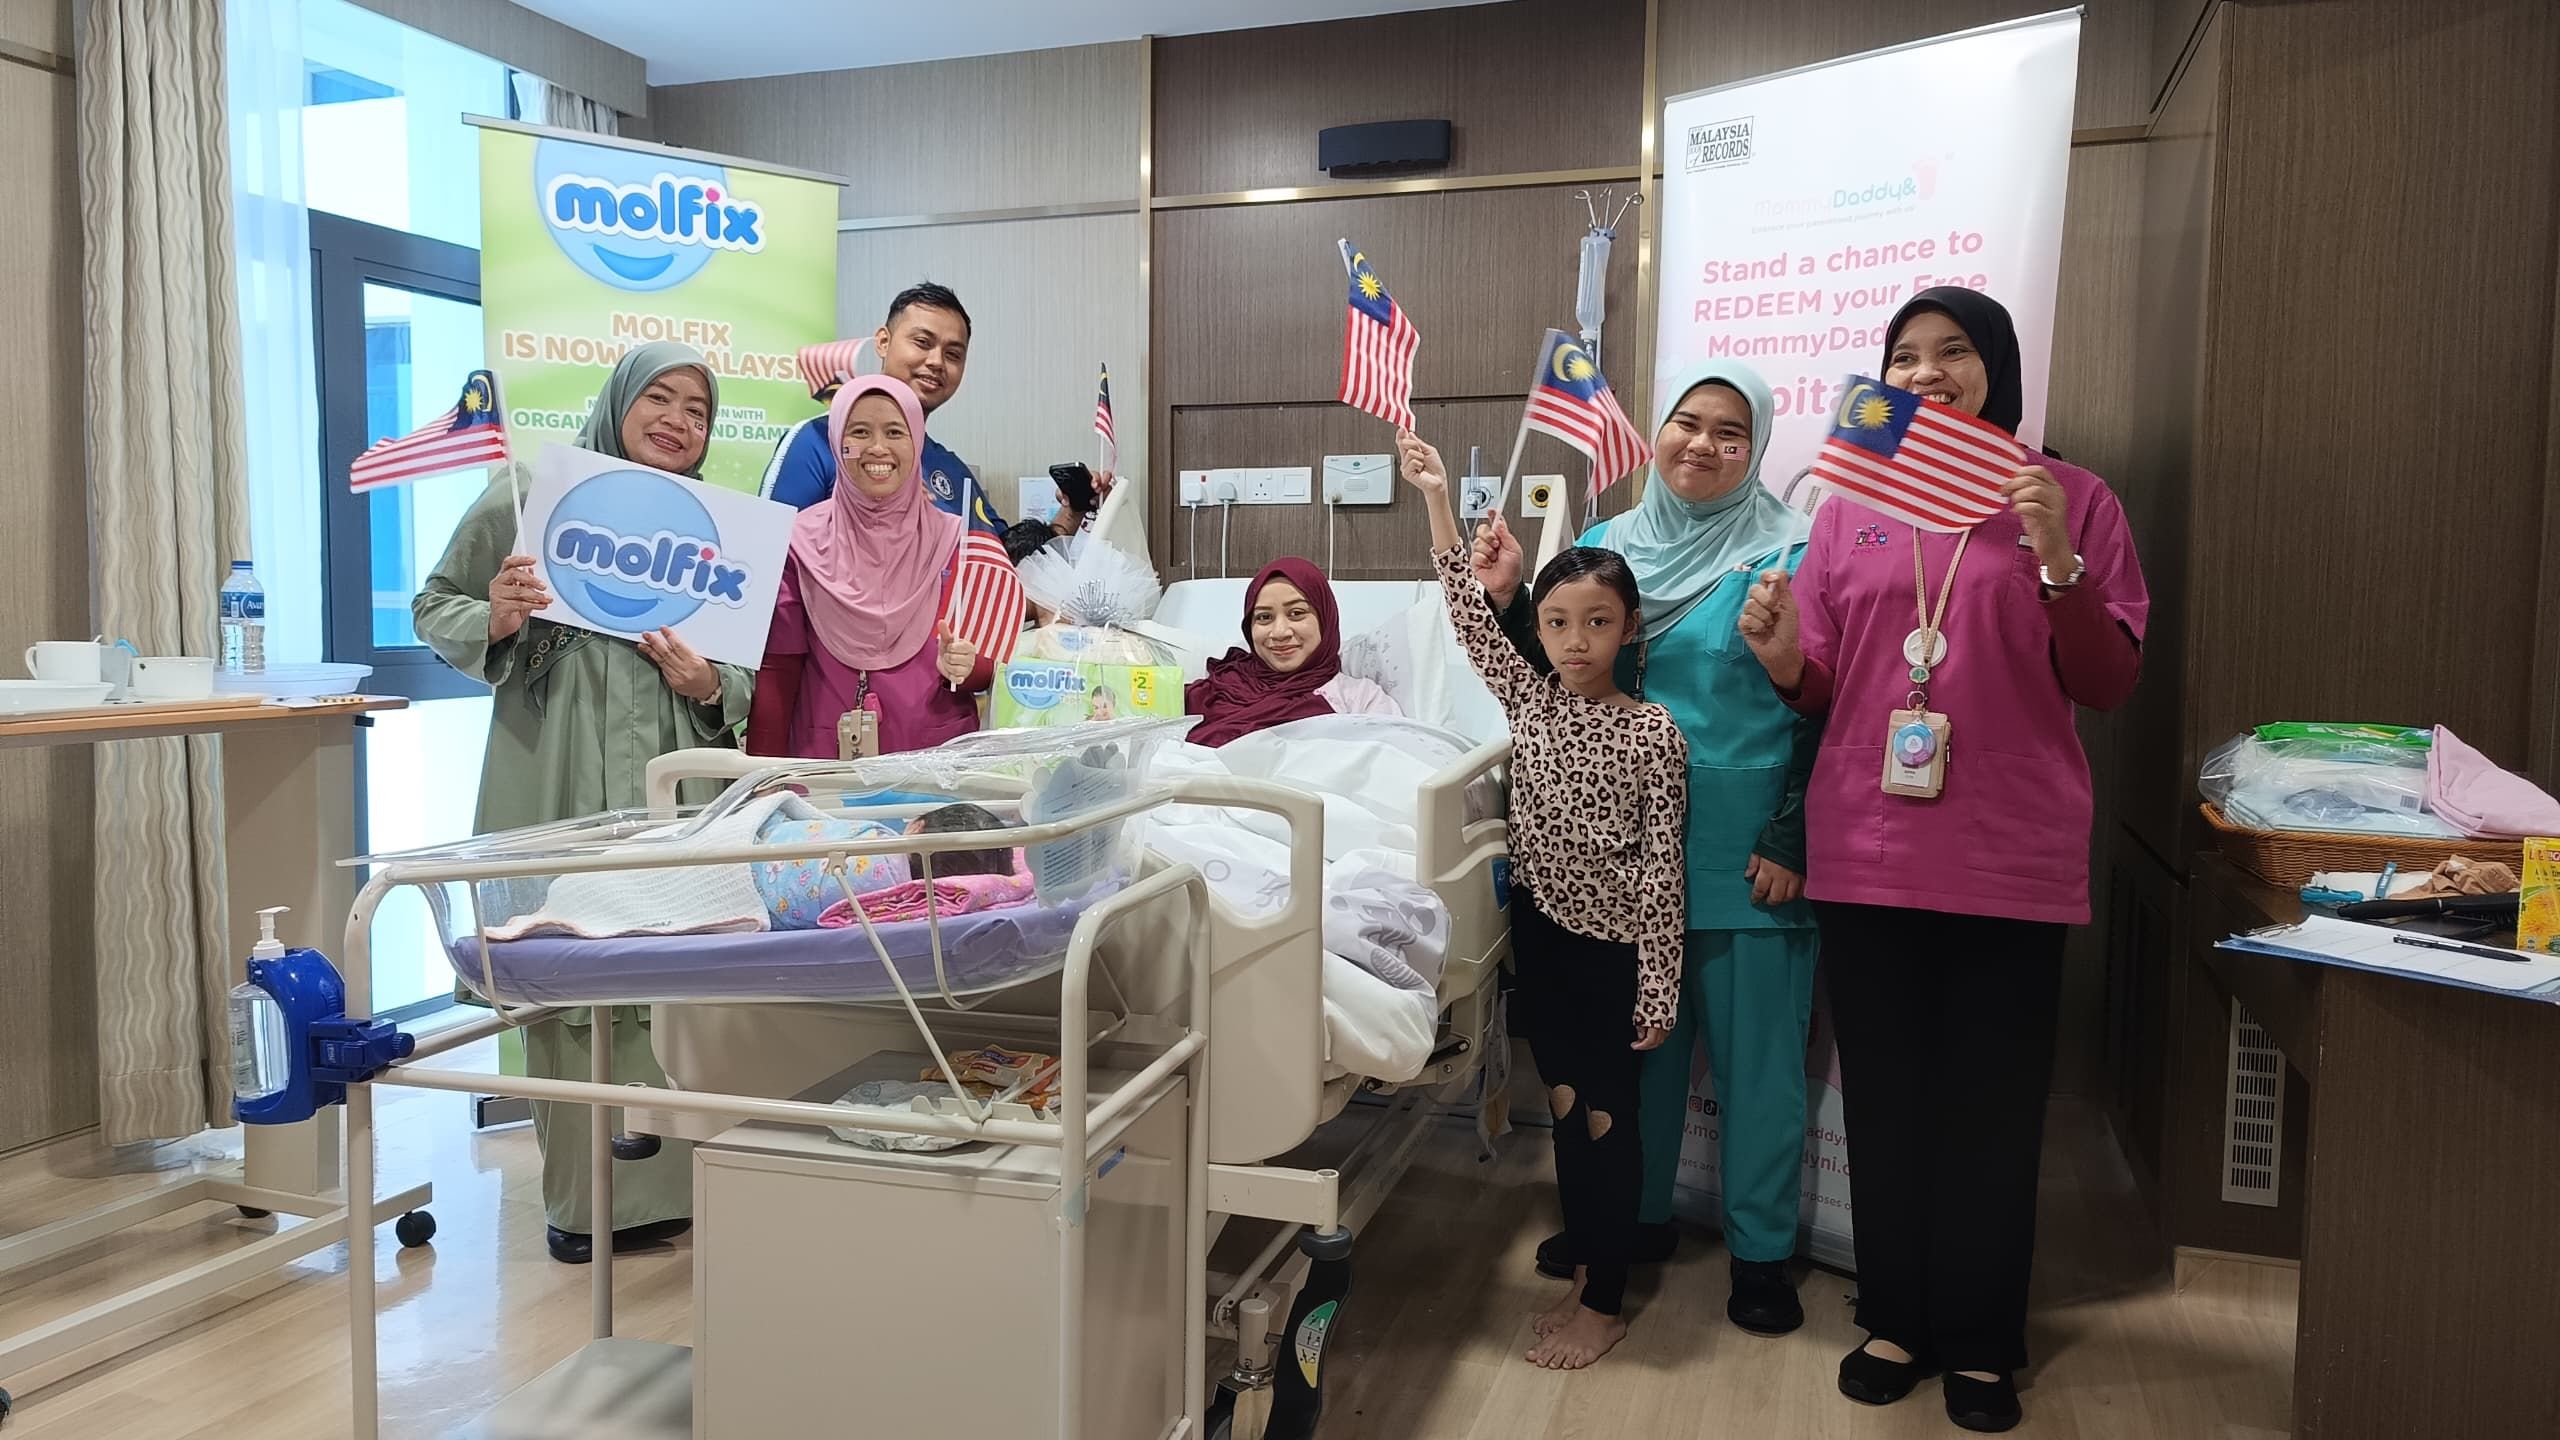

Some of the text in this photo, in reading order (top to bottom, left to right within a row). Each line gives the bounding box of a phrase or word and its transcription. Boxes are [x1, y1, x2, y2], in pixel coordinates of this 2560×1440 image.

[1690, 123, 1749, 146] MALAYSIA
[1702, 138, 1749, 163] RECORDS
[555, 181, 759, 246] molfix
[1703, 230, 1983, 284] Stand a chance to
[1694, 289, 1822, 323] REDEEM
[1833, 284, 1902, 316] your
[613, 314, 730, 347] MOLFIX
[1708, 321, 1888, 358] MommyDad
[505, 333, 626, 365] IS NOW
[704, 350, 804, 380] ALAYSI
[514, 411, 589, 430] ORGAN
[732, 409, 763, 421] WITH
[711, 423, 790, 441] ND BAM
[556, 527, 747, 602] molfix
[1011, 669, 1086, 692] molfix
